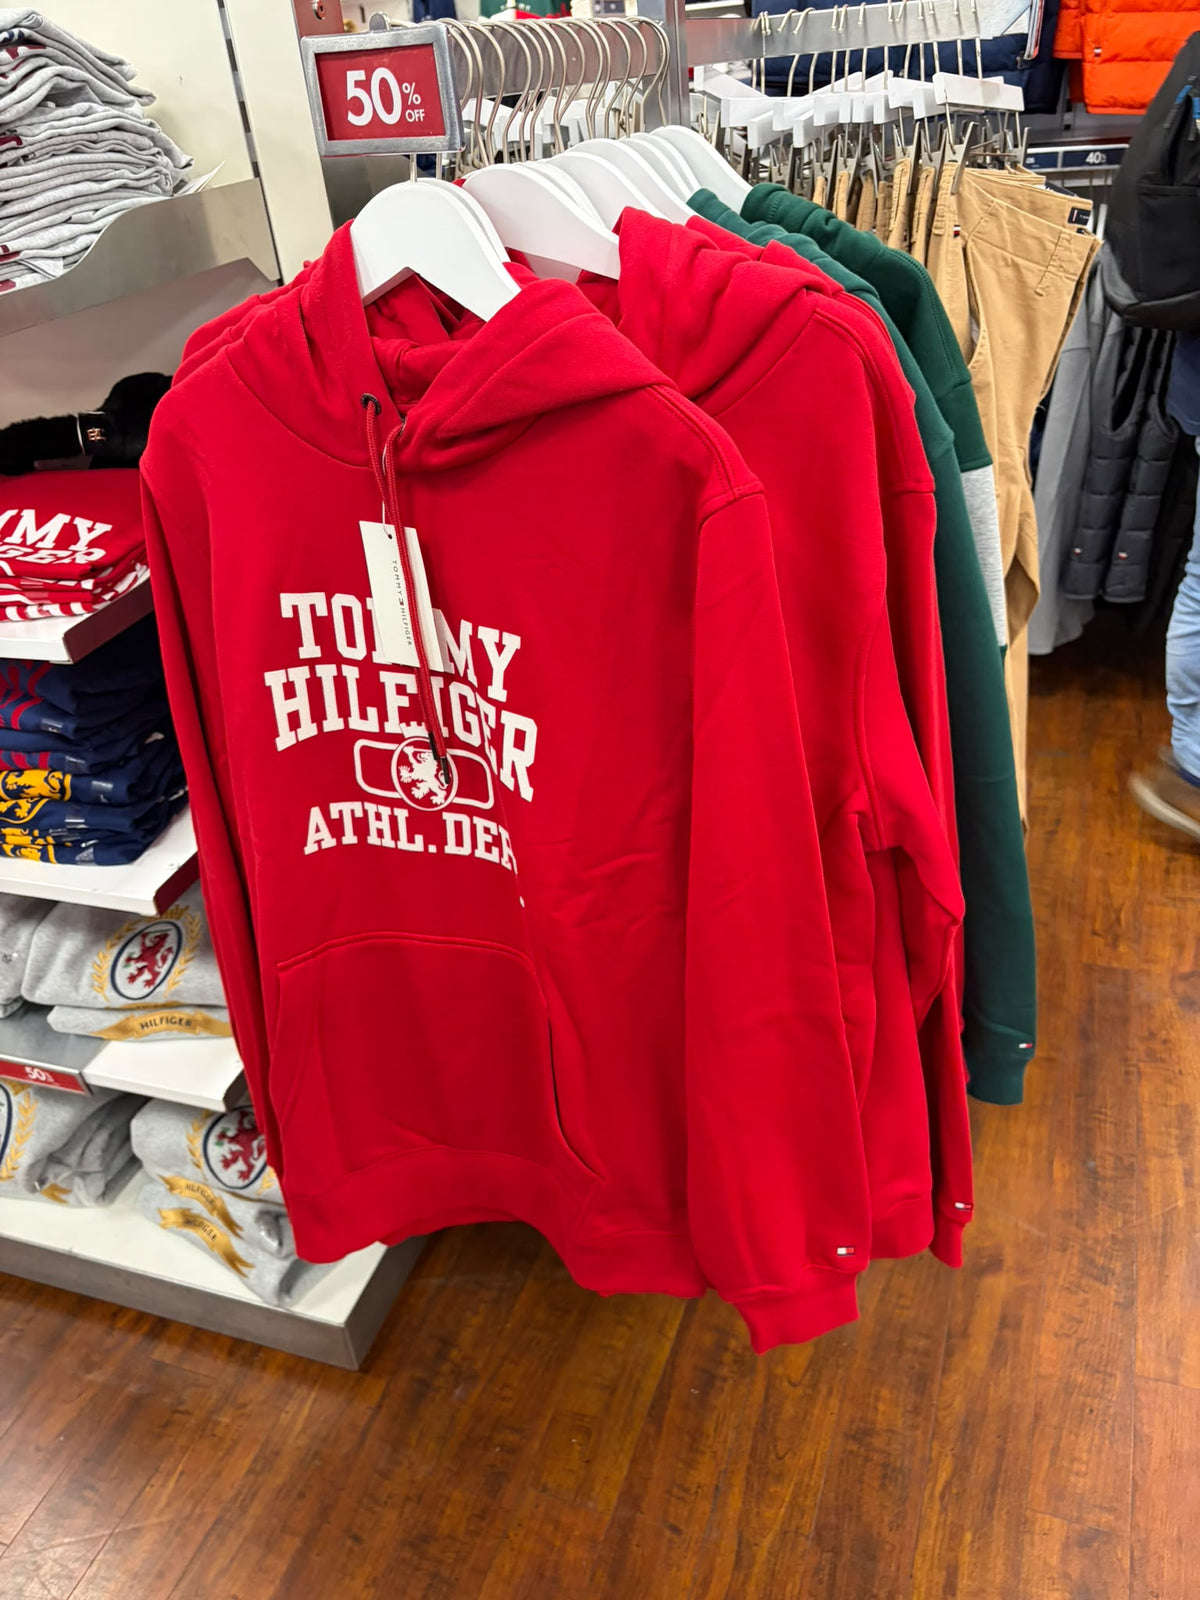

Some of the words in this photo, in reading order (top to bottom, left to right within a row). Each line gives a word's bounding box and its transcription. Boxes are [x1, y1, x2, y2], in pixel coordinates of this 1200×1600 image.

[346, 67, 422, 126] 50%
[405, 109, 425, 122] OFF
[392, 560, 403, 596] TOMMY
[400, 607, 413, 646] HILFIGER
[280, 592, 521, 702] TOMY
[139, 1016, 193, 1030] HILFIGER
